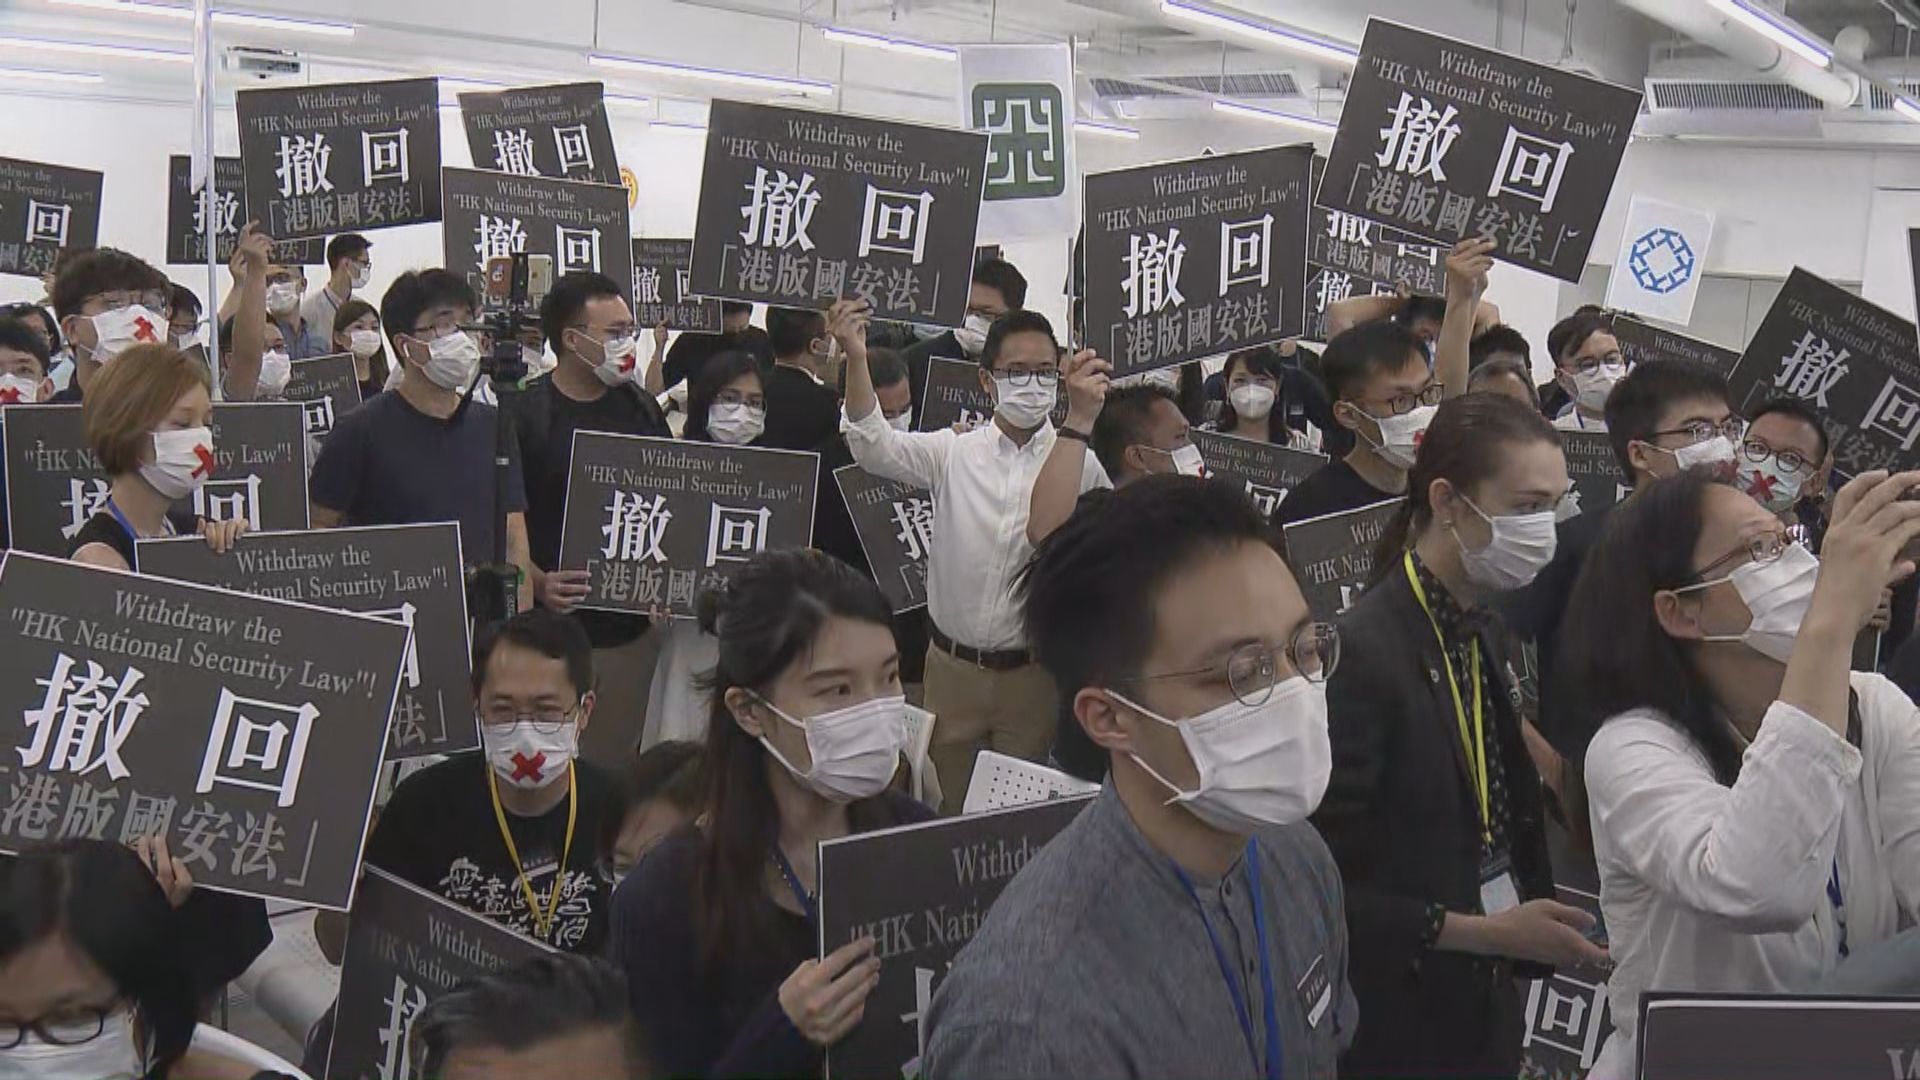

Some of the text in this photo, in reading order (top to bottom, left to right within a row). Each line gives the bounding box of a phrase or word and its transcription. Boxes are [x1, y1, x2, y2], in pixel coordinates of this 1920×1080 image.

[1439, 49, 1553, 100] Withdraw the
[297, 90, 381, 111] Withdraw the
[495, 110, 534, 126] National
[536, 107, 573, 123] Security
[500, 94, 561, 110] Withdraw the
[1371, 57, 1617, 144] "HK National Security Law"!
[250, 106, 431, 134] "HK National Security Law"!
[788, 120, 903, 153] Withdraw the
[721, 136, 970, 187] "HK National Security Law"!
[15, 180, 59, 200] Security
[497, 181, 575, 203] Withdraw the
[1153, 165, 1247, 198] Withdraw the
[26, 199, 71, 247] 回
[268, 183, 424, 235] 「港版國安法」
[453, 194, 622, 226] "HK National Security Law"!
[1098, 180, 1300, 232] "HK National Security Law"!
[1347, 162, 1566, 267] 「港版國安法」
[719, 243, 940, 316] 「港版國安法」
[1111, 287, 1283, 370] 「港版國安法」
[1818, 315, 1877, 354] National
[24, 449, 72, 471] "HK
[242, 442, 292, 464] Law"!
[641, 448, 743, 474] Withdraw the
[1566, 439, 1616, 457] ithdraw
[584, 465, 803, 503] "HK National Security Law"!
[1233, 461, 1277, 481] Security
[236, 546, 371, 574] Withdraw the
[1305, 558, 1339, 584] "HK
[309, 571, 388, 603] Security
[393, 566, 449, 592] Law"!
[114, 590, 282, 645] Withdraw the
[11, 608, 377, 698] "HK National Security Law"!
[1523, 973, 1608, 1069] 回
